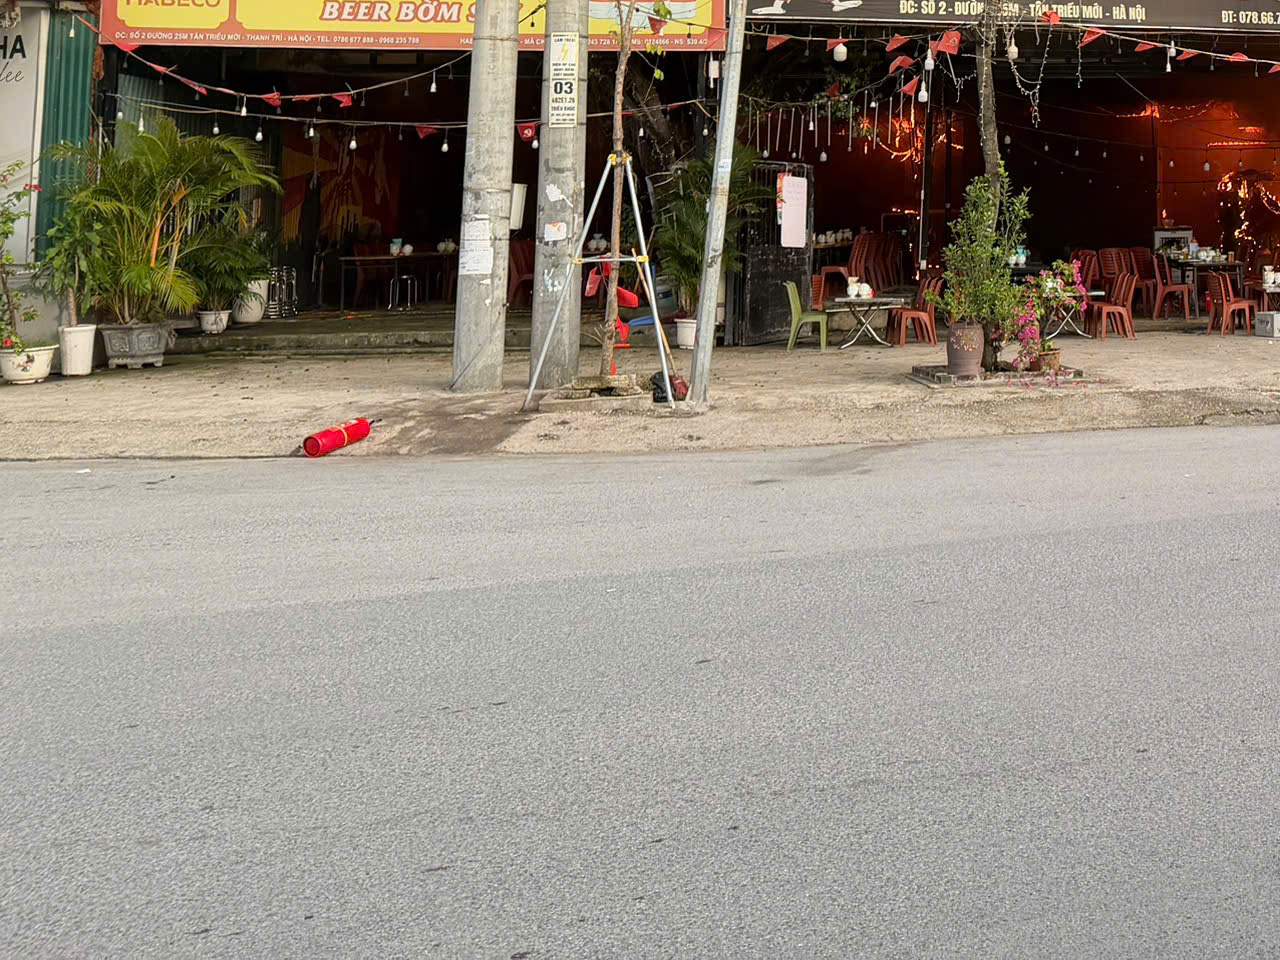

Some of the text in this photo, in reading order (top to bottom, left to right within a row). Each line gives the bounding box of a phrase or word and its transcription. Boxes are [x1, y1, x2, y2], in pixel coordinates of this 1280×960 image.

[320, 0, 390, 22] BEER
[939, 1, 947, 15] 2
[1082, 3, 1104, 20] MỚI
[1112, 4, 1128, 20] HÀ
[1129, 5, 1146, 23] NỘI
[554, 81, 574, 94] 03
